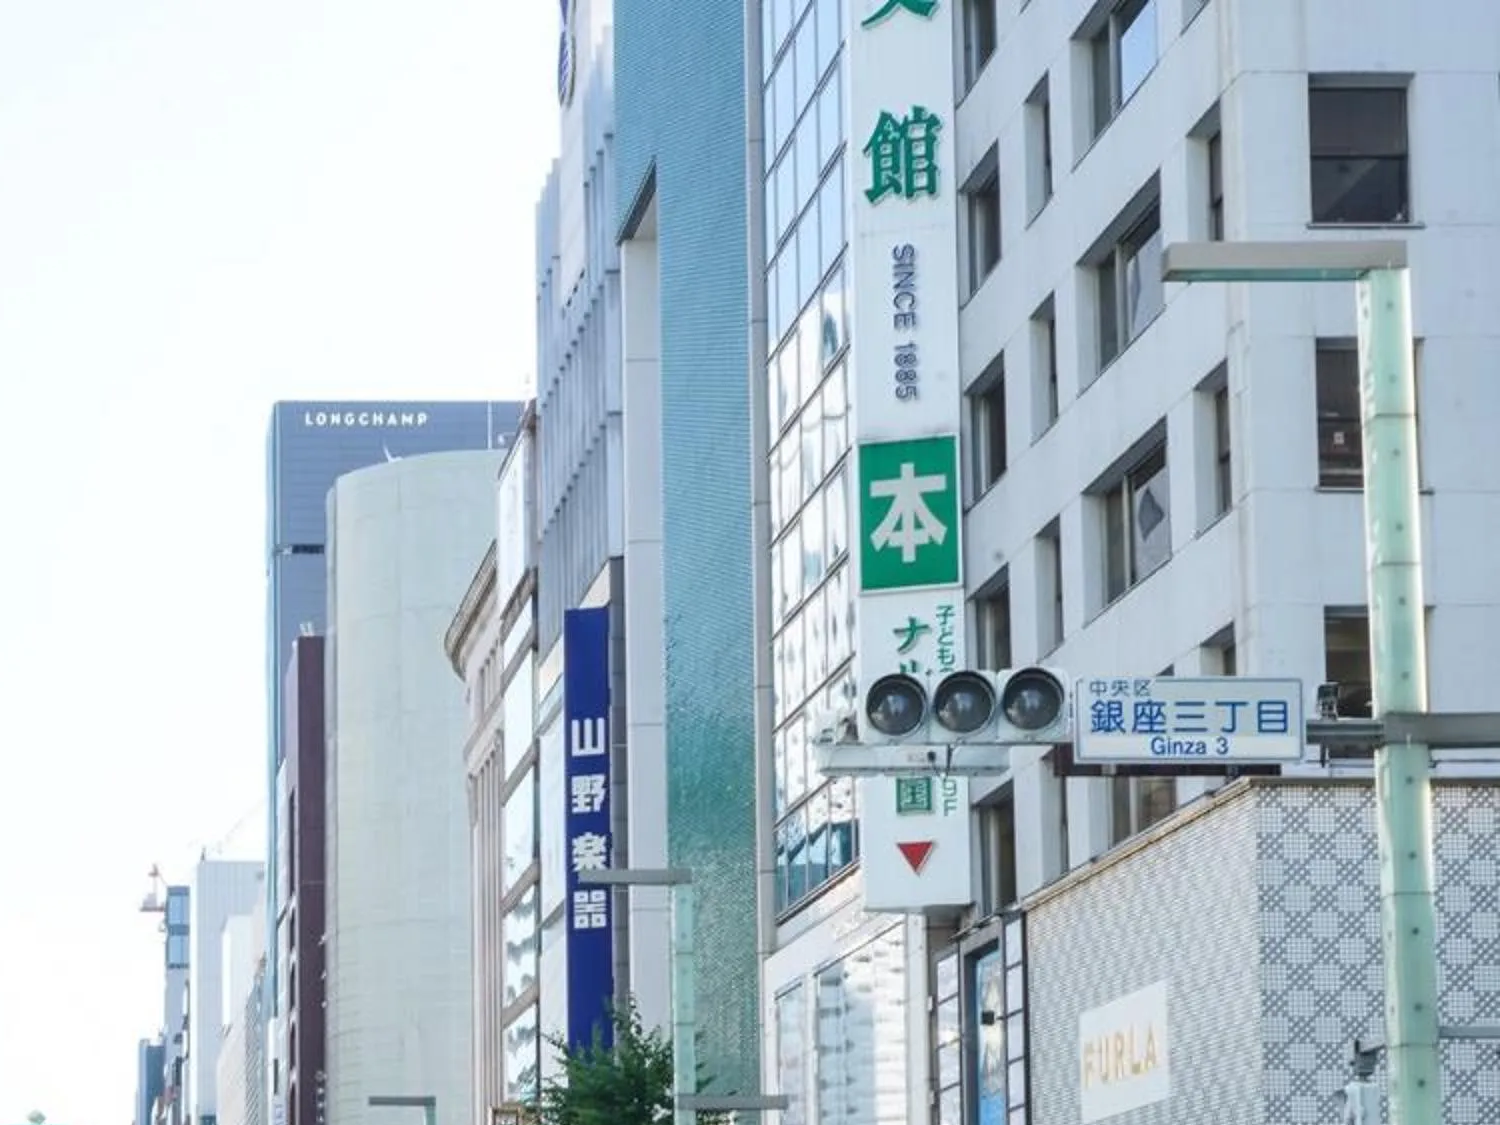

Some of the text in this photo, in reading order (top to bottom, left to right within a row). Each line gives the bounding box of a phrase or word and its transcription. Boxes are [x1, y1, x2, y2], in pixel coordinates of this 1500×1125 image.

[892, 243, 920, 402] SINCE 1885
[304, 411, 428, 427] LONGCHAMP
[868, 462, 948, 563] 本
[1090, 679, 1151, 697] 中央区
[1090, 700, 1289, 734] 銀座三丁目
[1150, 737, 1230, 756] Ginza 3
[571, 717, 607, 930] 山野楽器
[1083, 1022, 1158, 1090] FURLA
